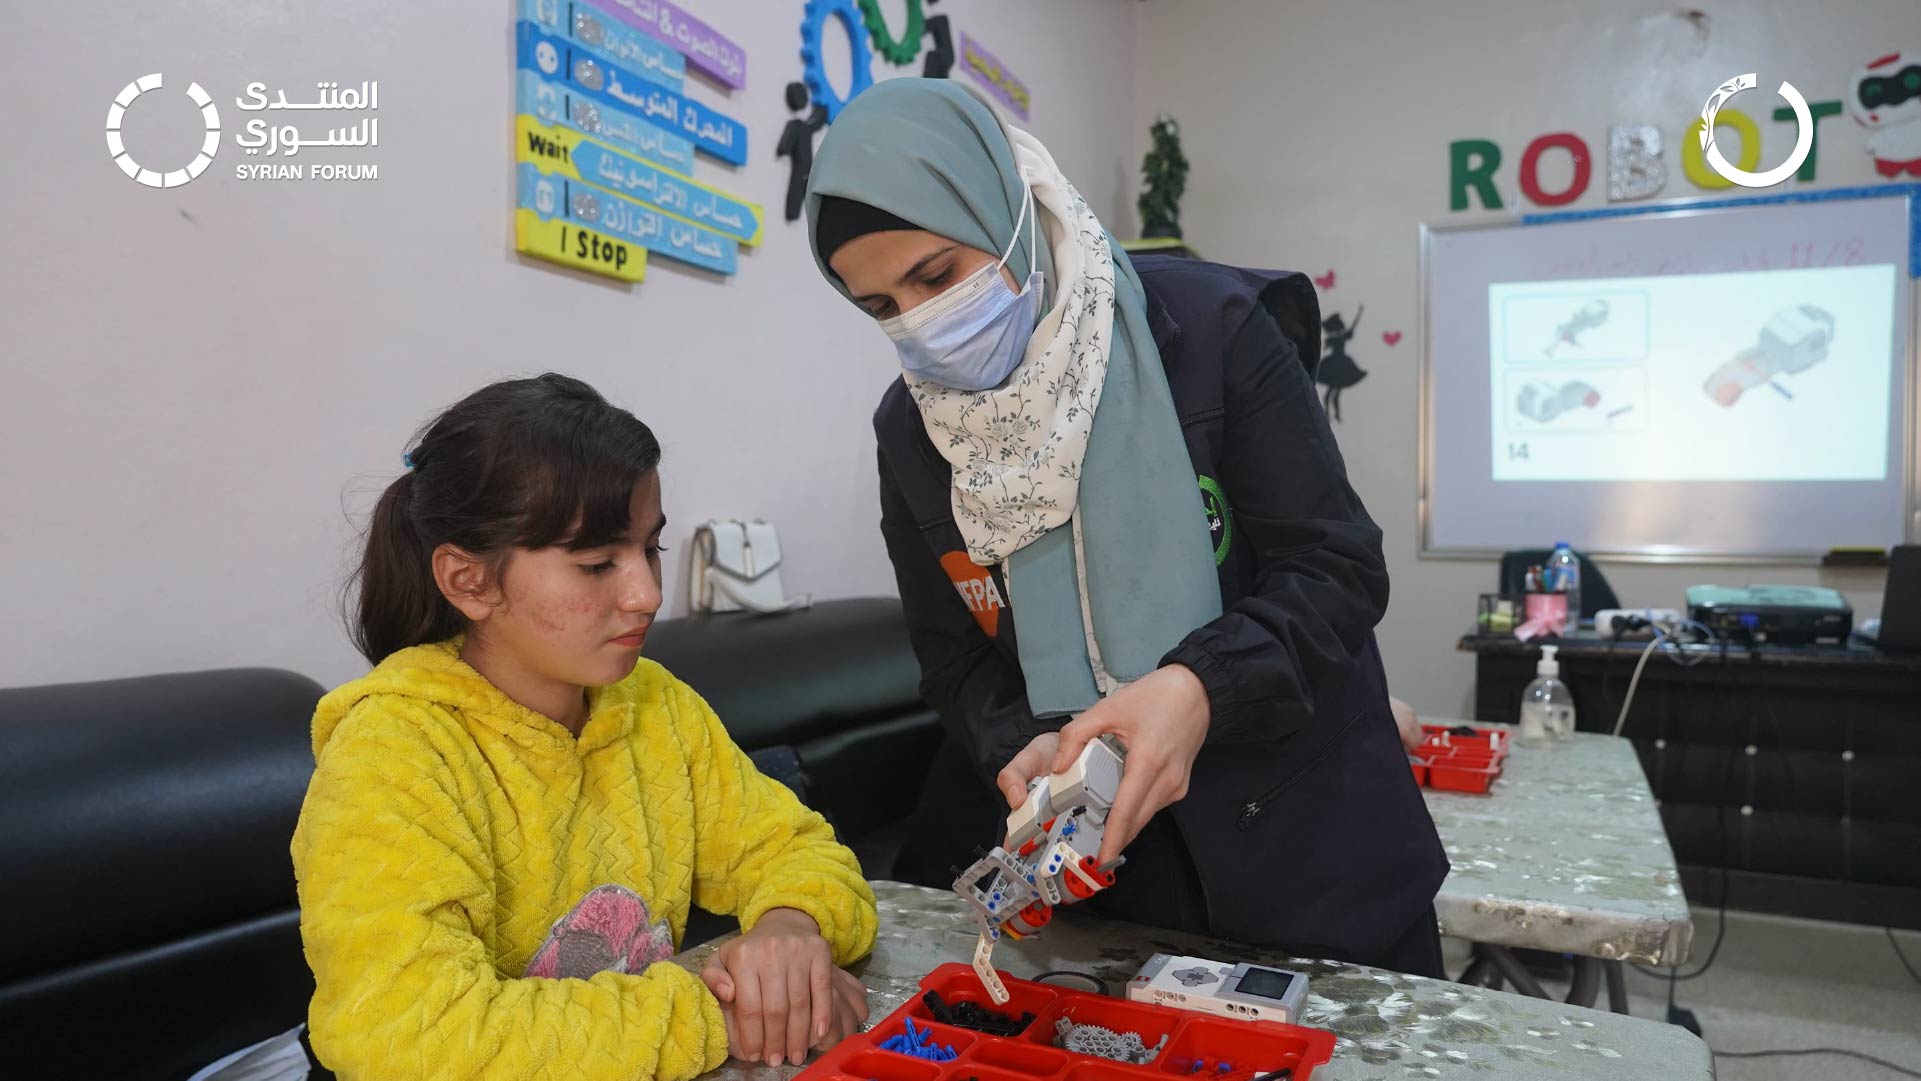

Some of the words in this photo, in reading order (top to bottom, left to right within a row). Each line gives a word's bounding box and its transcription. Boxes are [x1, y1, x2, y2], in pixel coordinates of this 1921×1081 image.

[659, 8, 674, 37] &
[607, 70, 678, 126] المتوسط
[683, 106, 733, 149] المحرك
[528, 131, 569, 164] Wait
[1449, 99, 1843, 212] ROBOT
[604, 200, 663, 238] التوازن
[692, 195, 743, 229] حساس
[577, 230, 628, 270] Stop
[670, 228, 723, 259] حساس
[1507, 440, 1530, 461] 14
